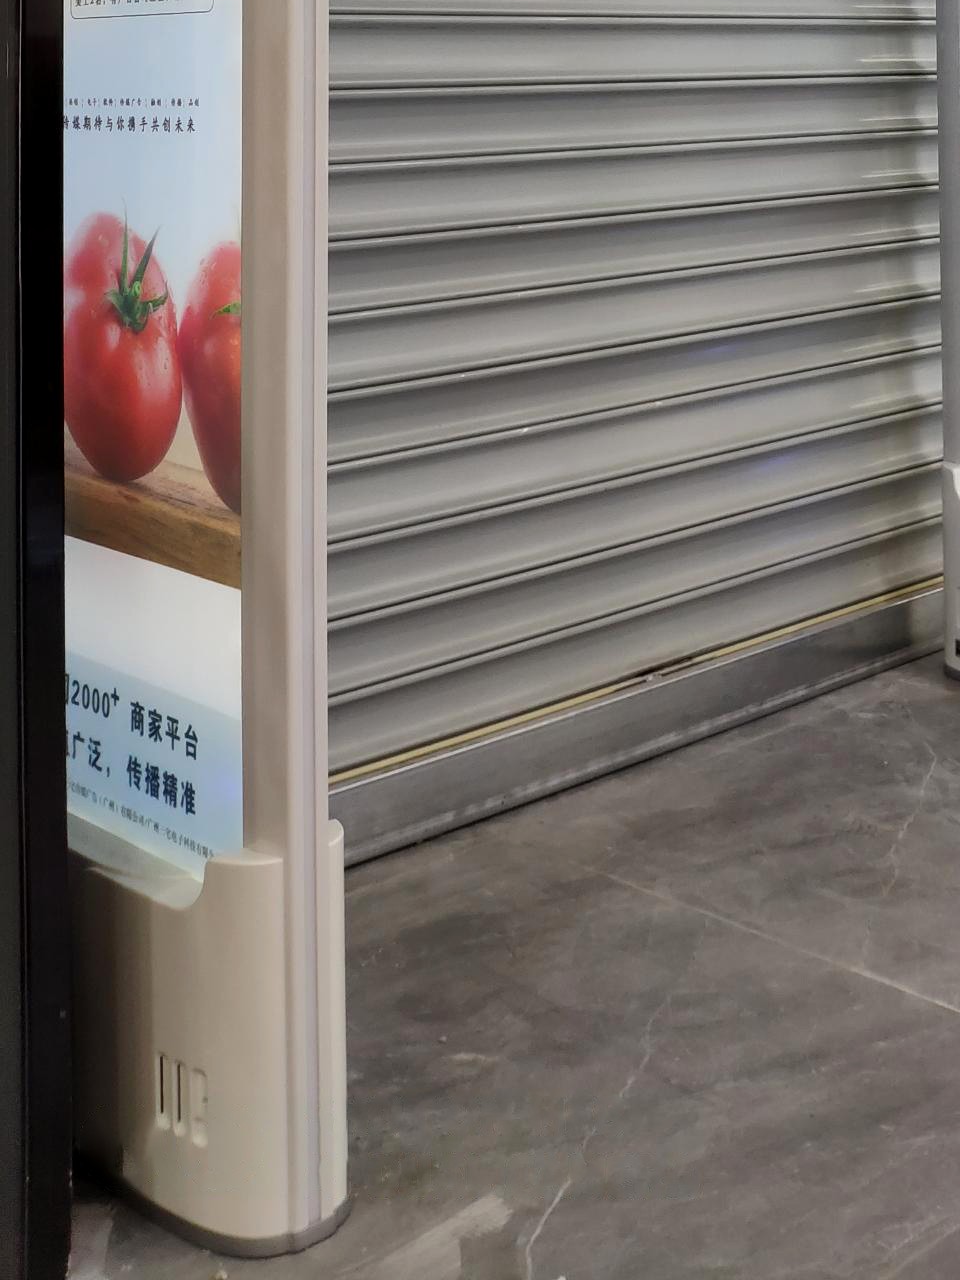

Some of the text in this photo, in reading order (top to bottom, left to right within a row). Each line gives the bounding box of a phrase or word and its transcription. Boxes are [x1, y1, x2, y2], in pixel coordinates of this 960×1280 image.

[65, 673, 199, 761] 2000+ 商家平台
[66, 730, 197, 816] 广泛， 传播精准
